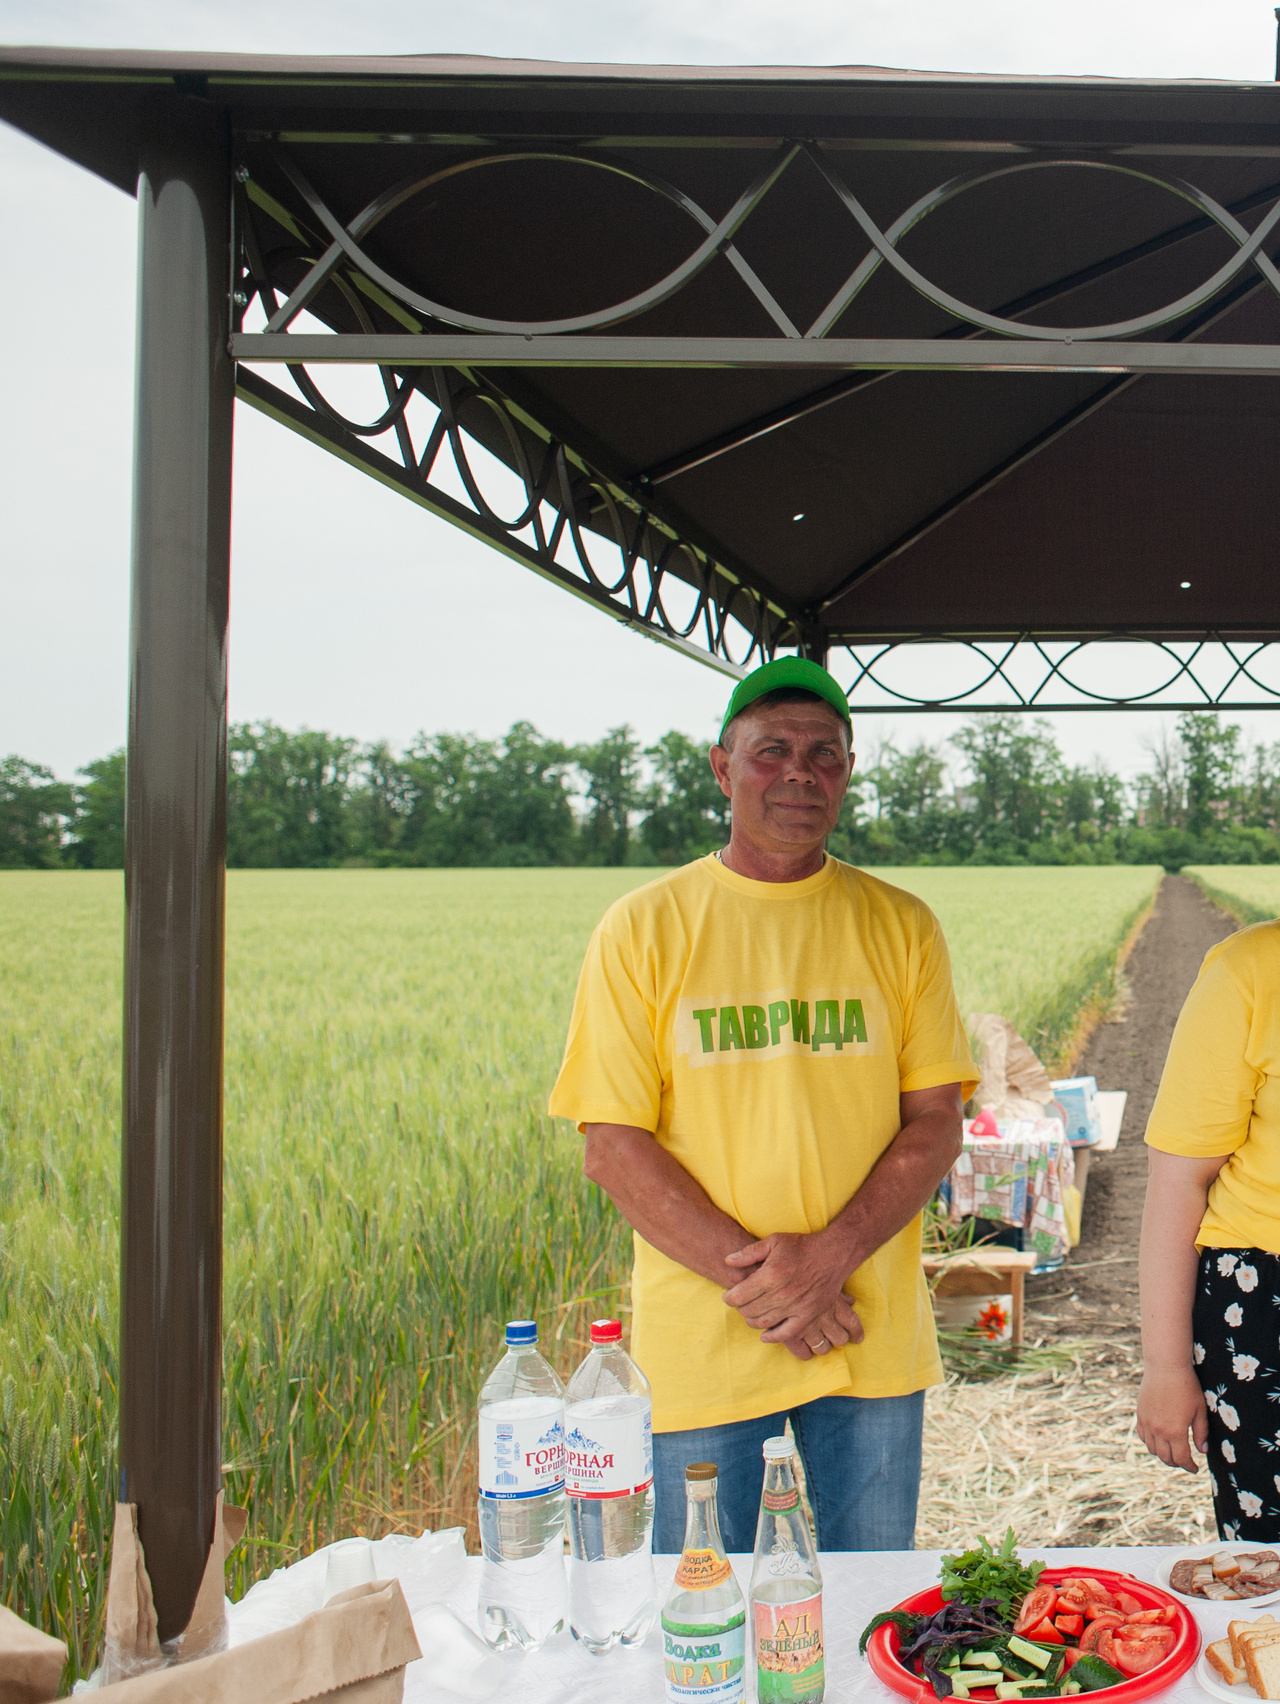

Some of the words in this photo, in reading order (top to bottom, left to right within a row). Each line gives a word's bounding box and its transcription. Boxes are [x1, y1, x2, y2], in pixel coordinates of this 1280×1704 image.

[692, 999, 868, 1053] ТАВРИДА
[525, 1442, 565, 1467] ГОРН
[564, 1448, 614, 1469] ОРНАЯ
[667, 1659, 732, 1687] АРАТ
